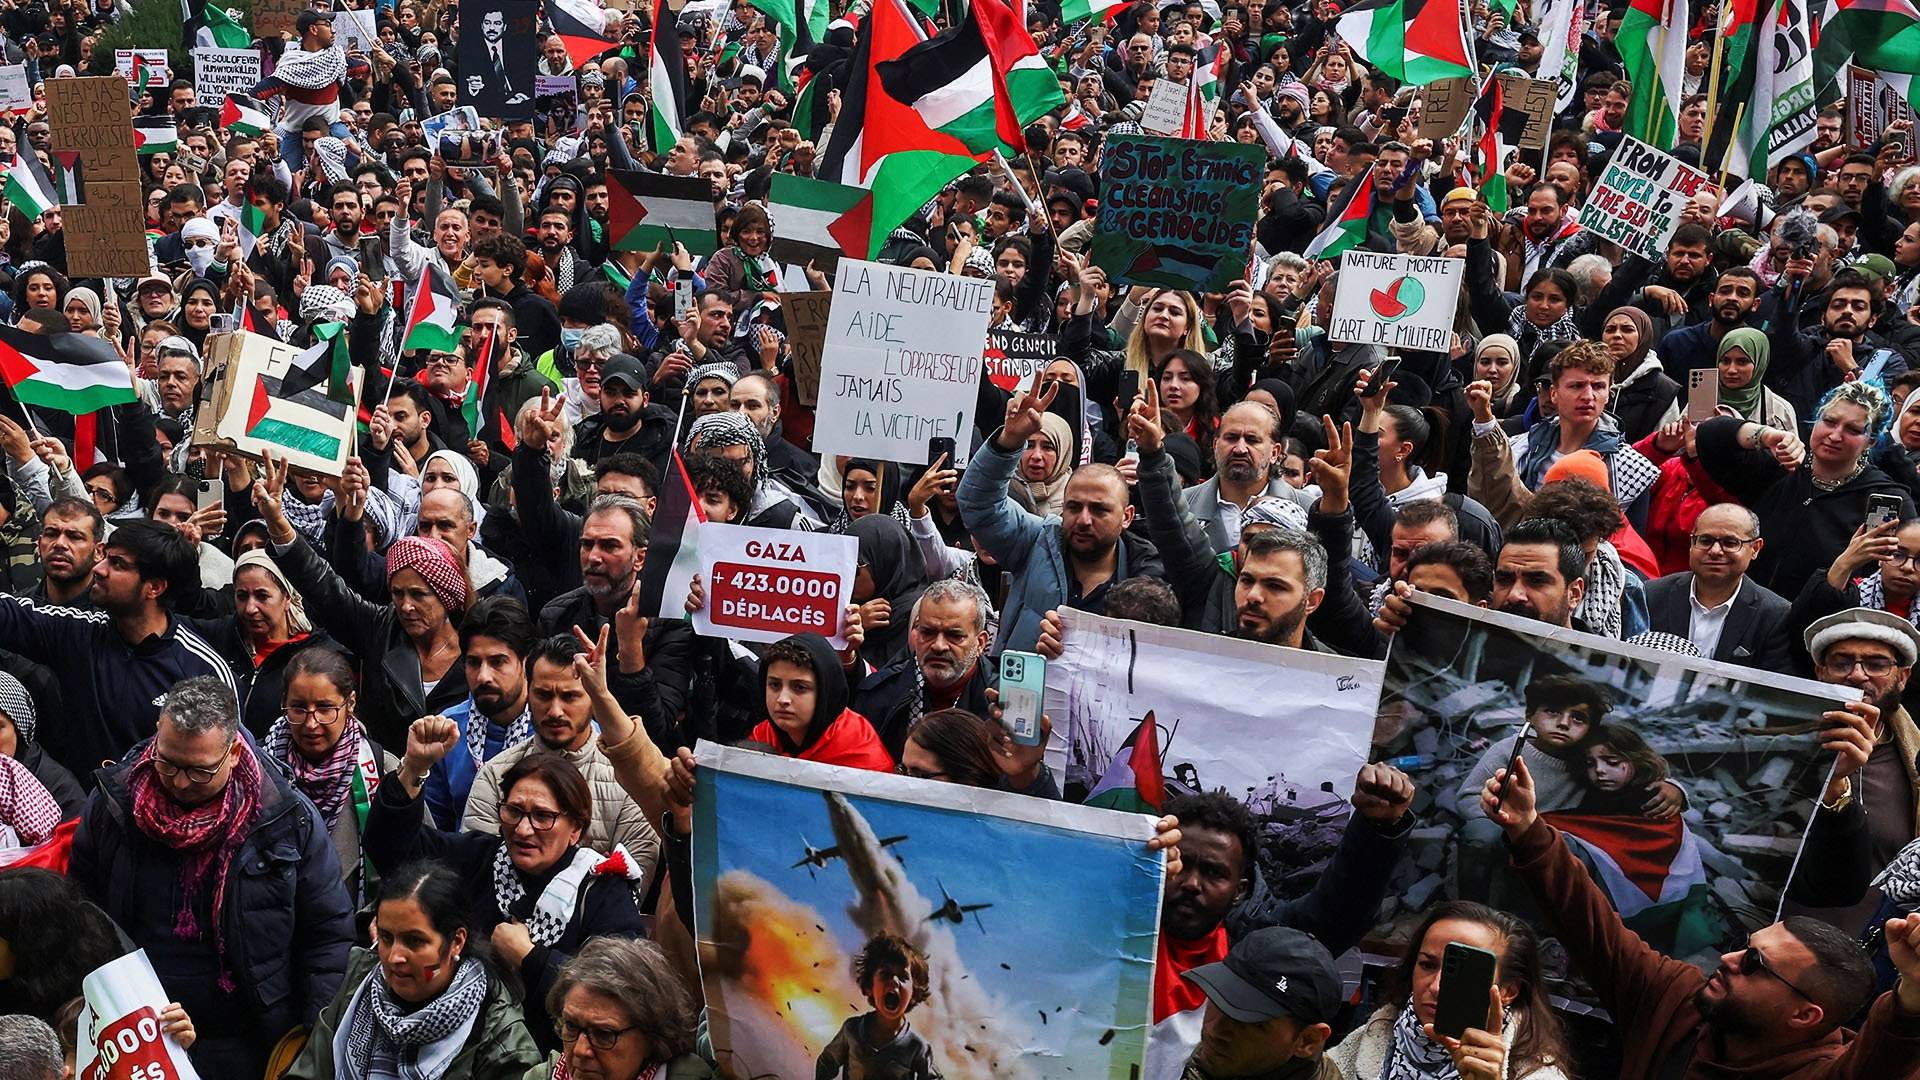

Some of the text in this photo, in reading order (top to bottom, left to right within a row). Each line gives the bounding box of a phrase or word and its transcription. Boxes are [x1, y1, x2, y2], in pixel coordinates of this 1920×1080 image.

[196, 53, 260, 65] THE SOUL OF EVERY
[234, 65, 258, 75] KILLED
[56, 80, 124, 102] HAMAS
[196, 83, 213, 94] ALL
[198, 73, 256, 86] WILL HAUNT YOU
[91, 101, 121, 122] PAS
[1425, 80, 1451, 124] FREE
[1863, 80, 1873, 144] ABDALLAH
[51, 124, 134, 148] TERRORISTE
[1109, 141, 1176, 181] STOP
[1616, 137, 1706, 198] FROM THE
[1592, 185, 1626, 215] THE
[1618, 200, 1651, 228] SEA
[64, 208, 145, 233] CHILD KILLERS
[1103, 209, 1118, 233] &
[71, 248, 148, 274] TERRORISTS
[1347, 253, 1451, 275] NATURE MORTE
[841, 264, 871, 296] LA
[985, 333, 1008, 351] END
[1331, 318, 1366, 341] L'ART
[1372, 322, 1391, 344] DE
[884, 348, 979, 385] L'OPPRESSEUR
[985, 357, 1032, 377] STAND
[854, 410, 873, 437] LA
[745, 540, 806, 563] GAZA
[713, 571, 837, 599] + 423.0000
[722, 597, 826, 627] DÉPLACÉS
